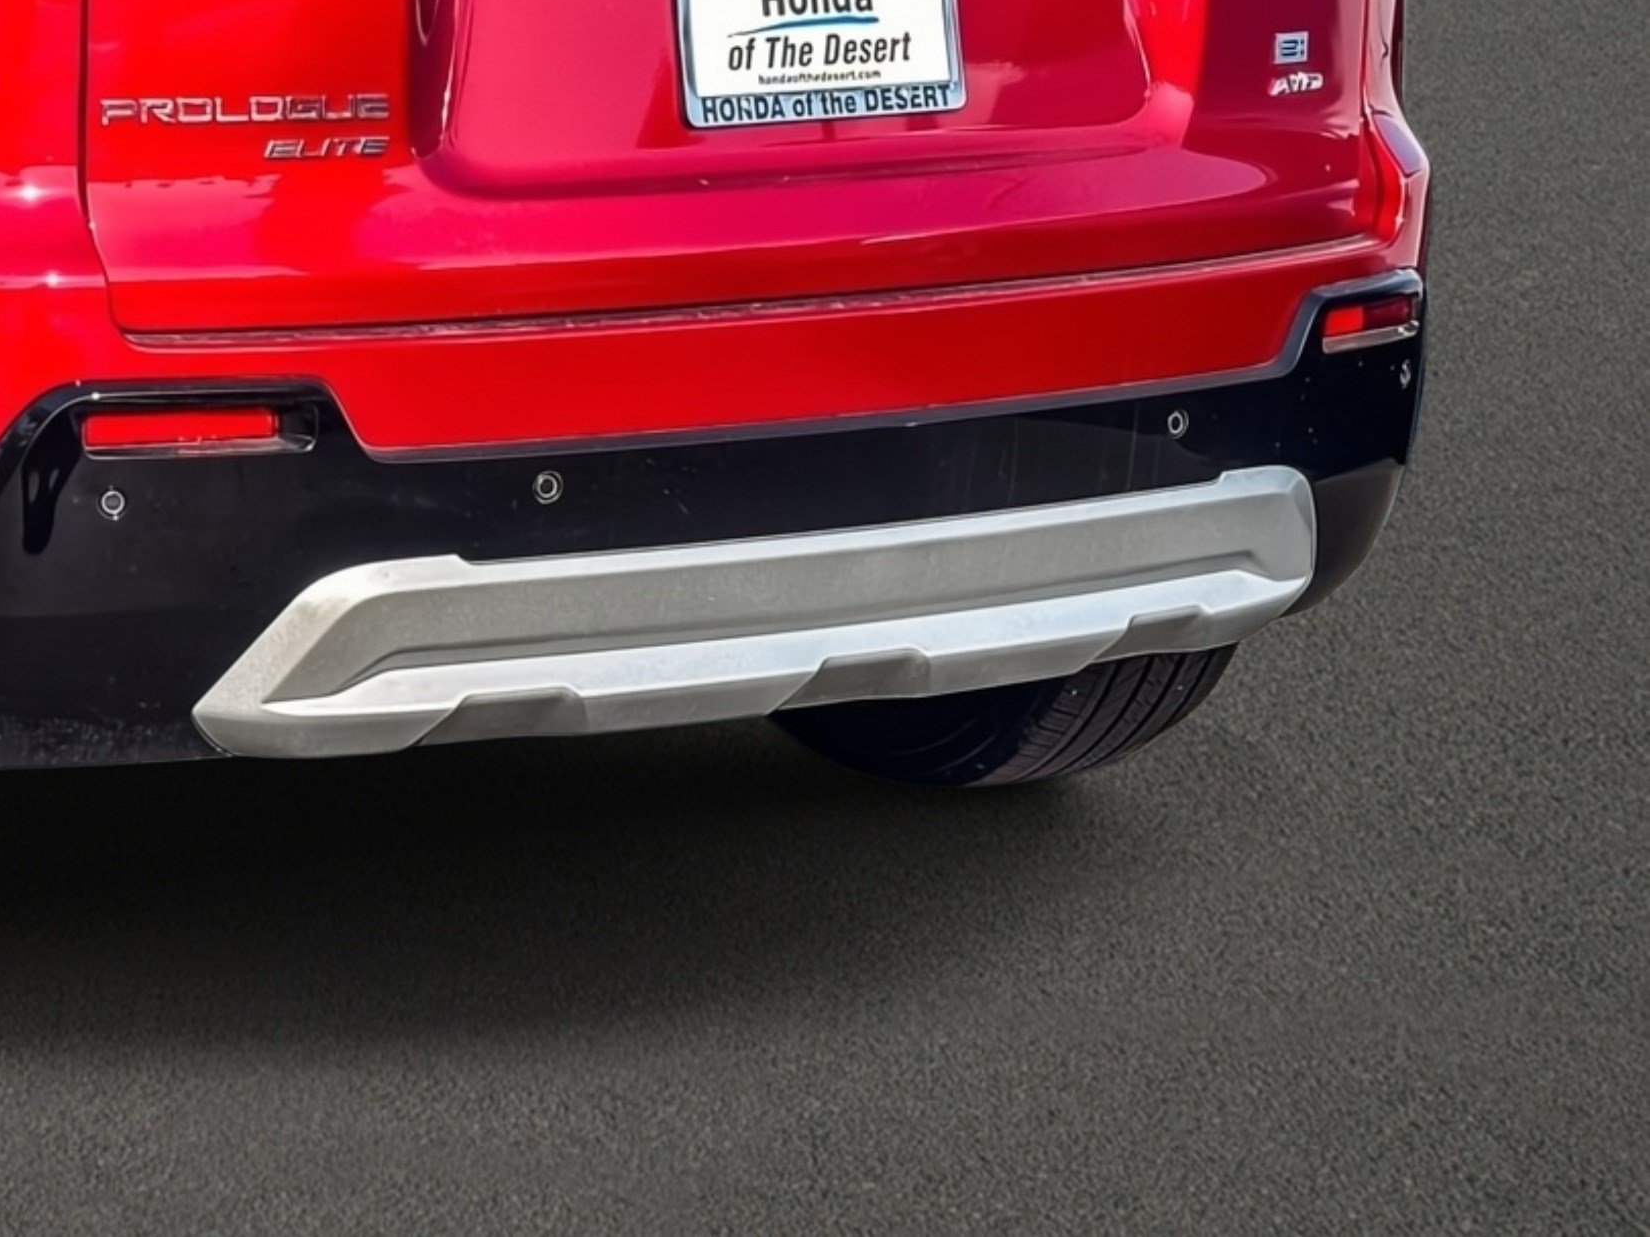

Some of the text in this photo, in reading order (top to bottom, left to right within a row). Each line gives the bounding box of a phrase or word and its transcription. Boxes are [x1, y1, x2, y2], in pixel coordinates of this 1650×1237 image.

[728, 31, 912, 71] of The Desert
[100, 93, 390, 126] PROLOGUE
[700, 84, 951, 123] HONDA of the DESERT
[263, 136, 391, 159] ELITE
